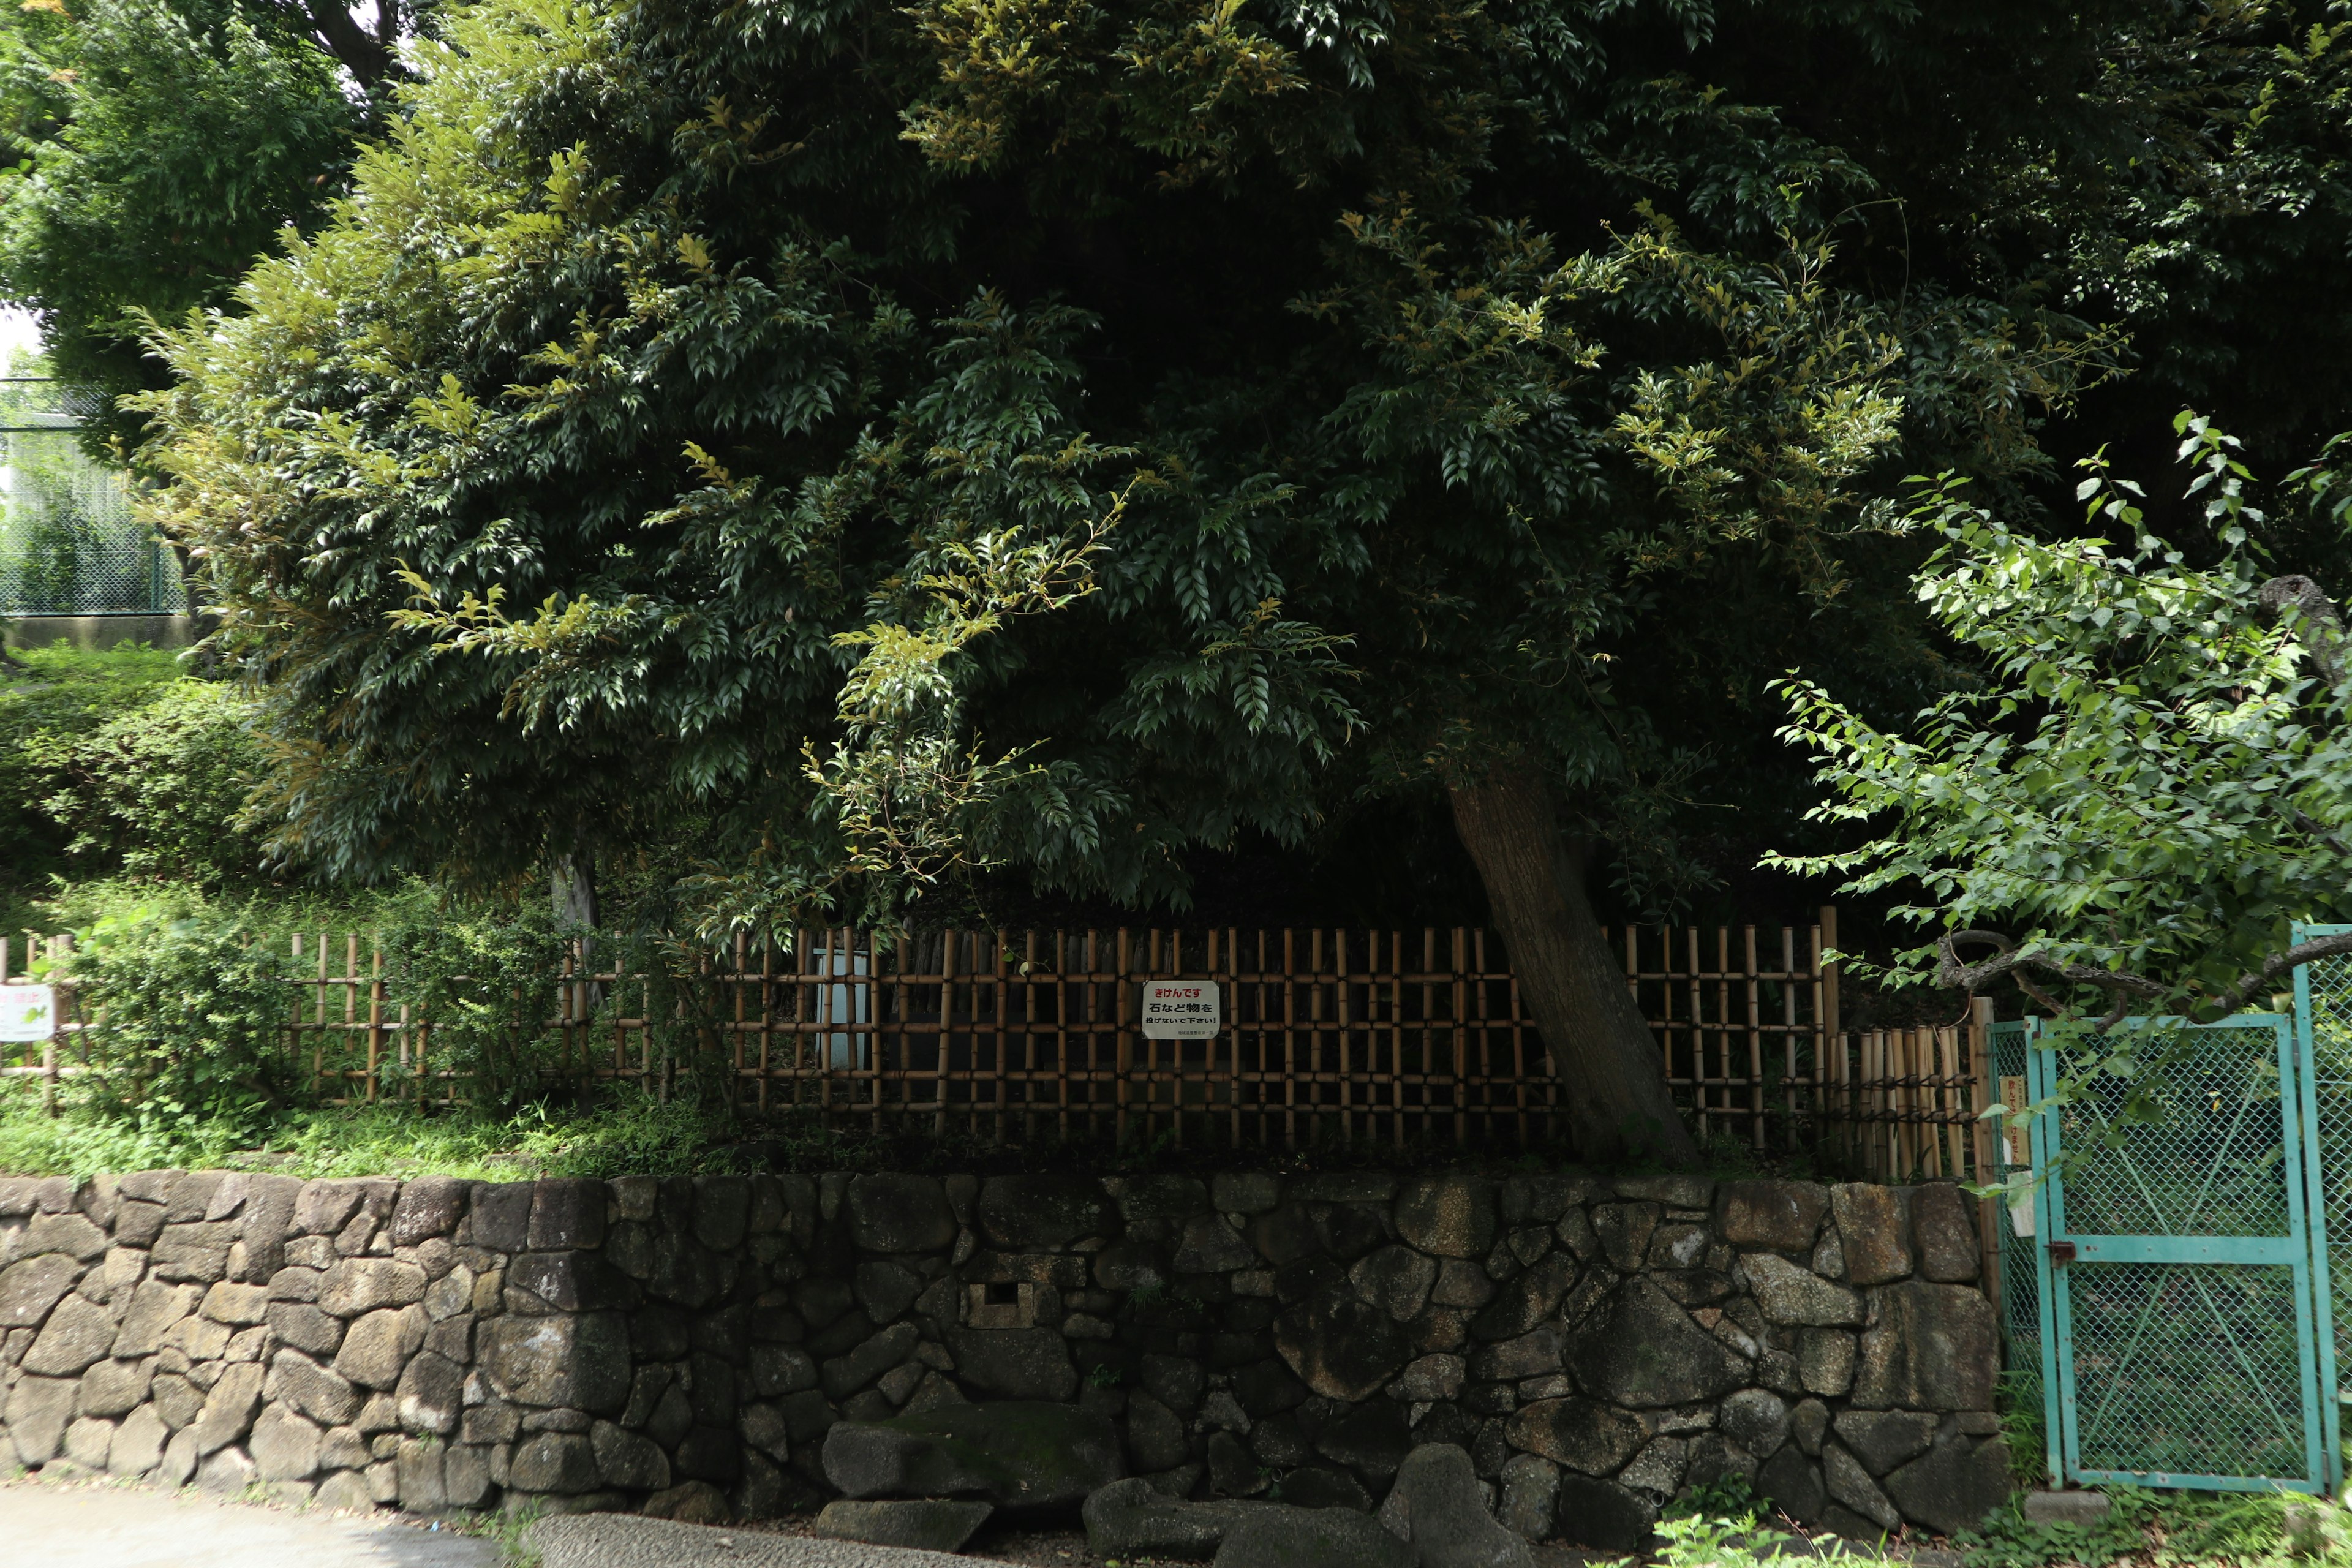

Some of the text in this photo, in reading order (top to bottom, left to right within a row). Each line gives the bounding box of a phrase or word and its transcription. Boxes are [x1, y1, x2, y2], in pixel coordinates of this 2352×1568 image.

[1155, 988, 1202, 998] きけんです
[1149, 1003, 1213, 1013] 石など物を
